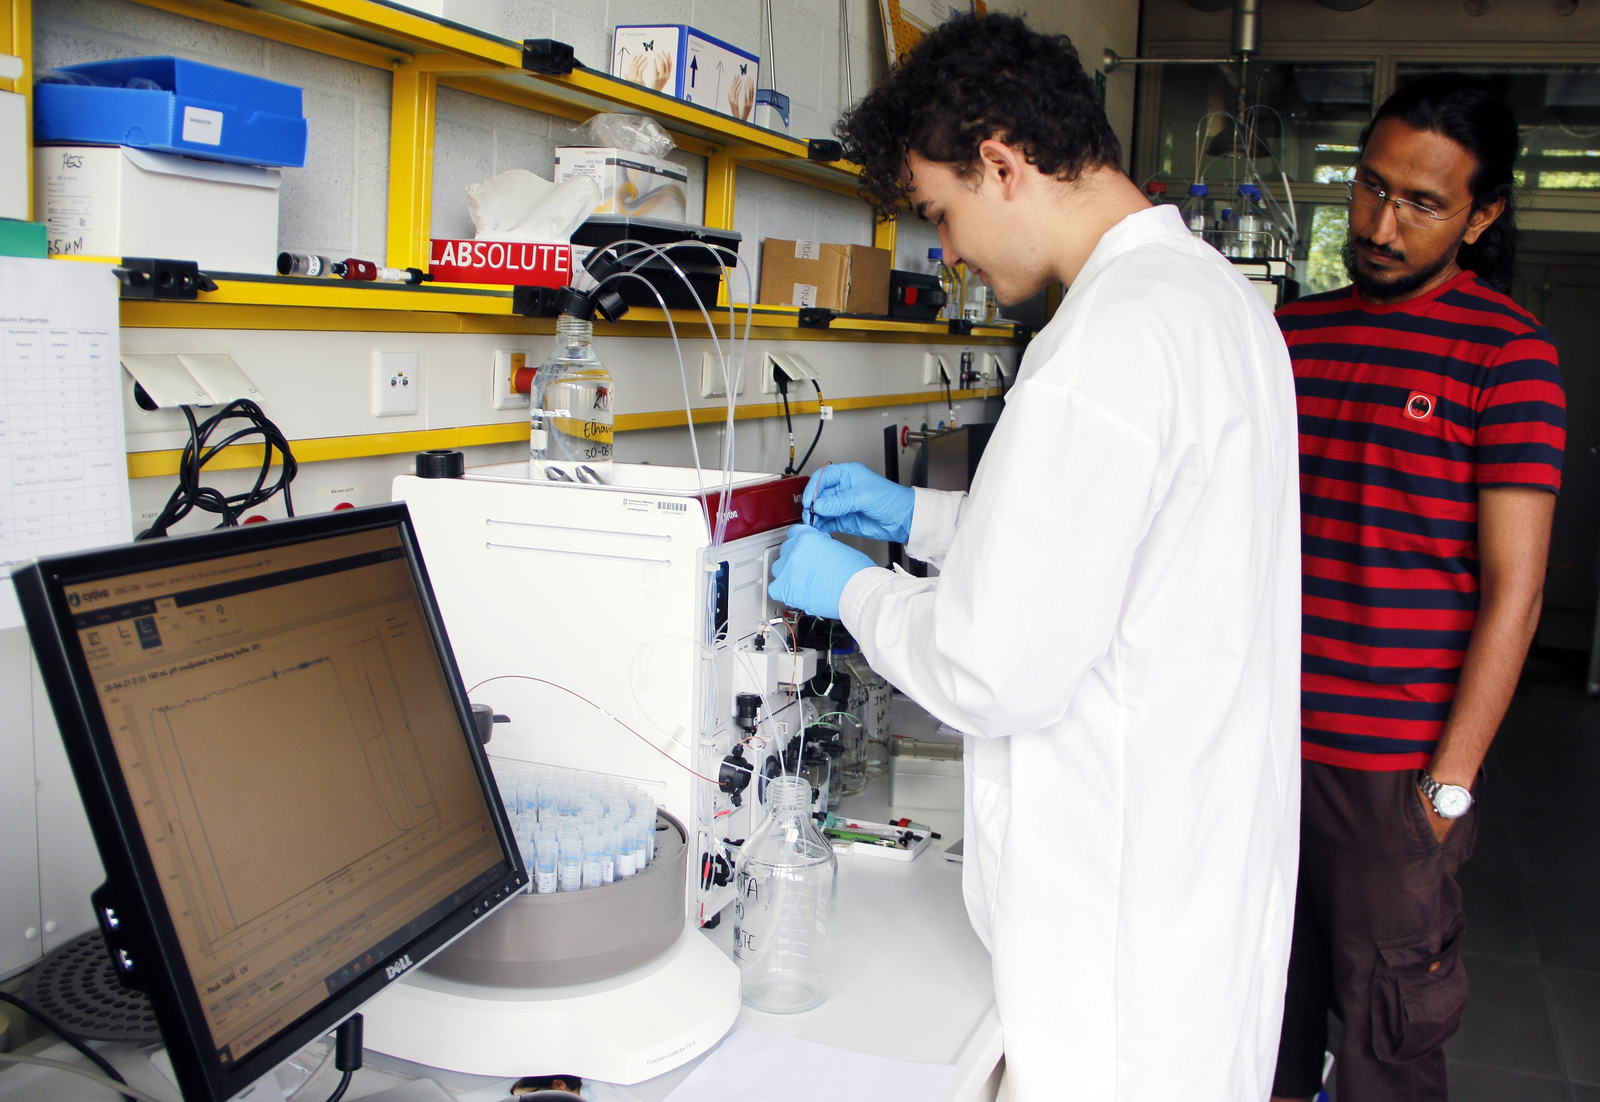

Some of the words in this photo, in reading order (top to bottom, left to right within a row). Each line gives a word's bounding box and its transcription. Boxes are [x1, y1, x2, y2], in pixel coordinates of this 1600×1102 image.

[429, 240, 569, 273] LABSOLUTE
[141, 511, 159, 519] Argon
[82, 588, 110, 602] cytiva
[384, 954, 413, 980] DELL
